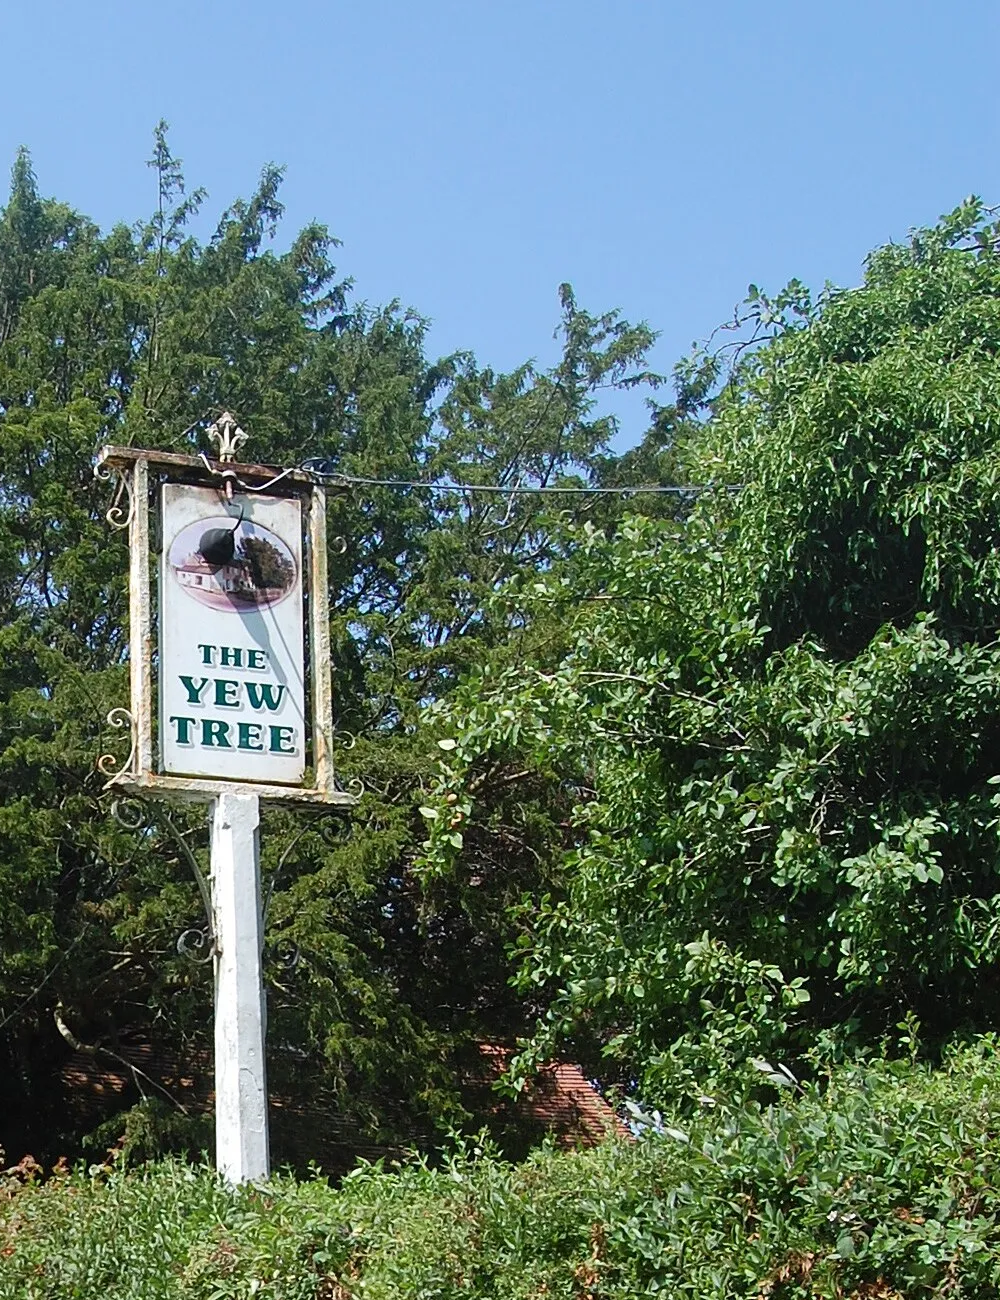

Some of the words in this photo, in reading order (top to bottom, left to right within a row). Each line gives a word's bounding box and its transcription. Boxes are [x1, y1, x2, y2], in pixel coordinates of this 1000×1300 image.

[198, 644, 266, 670] THE
[178, 675, 285, 711] YEW
[169, 716, 295, 753] TREE
